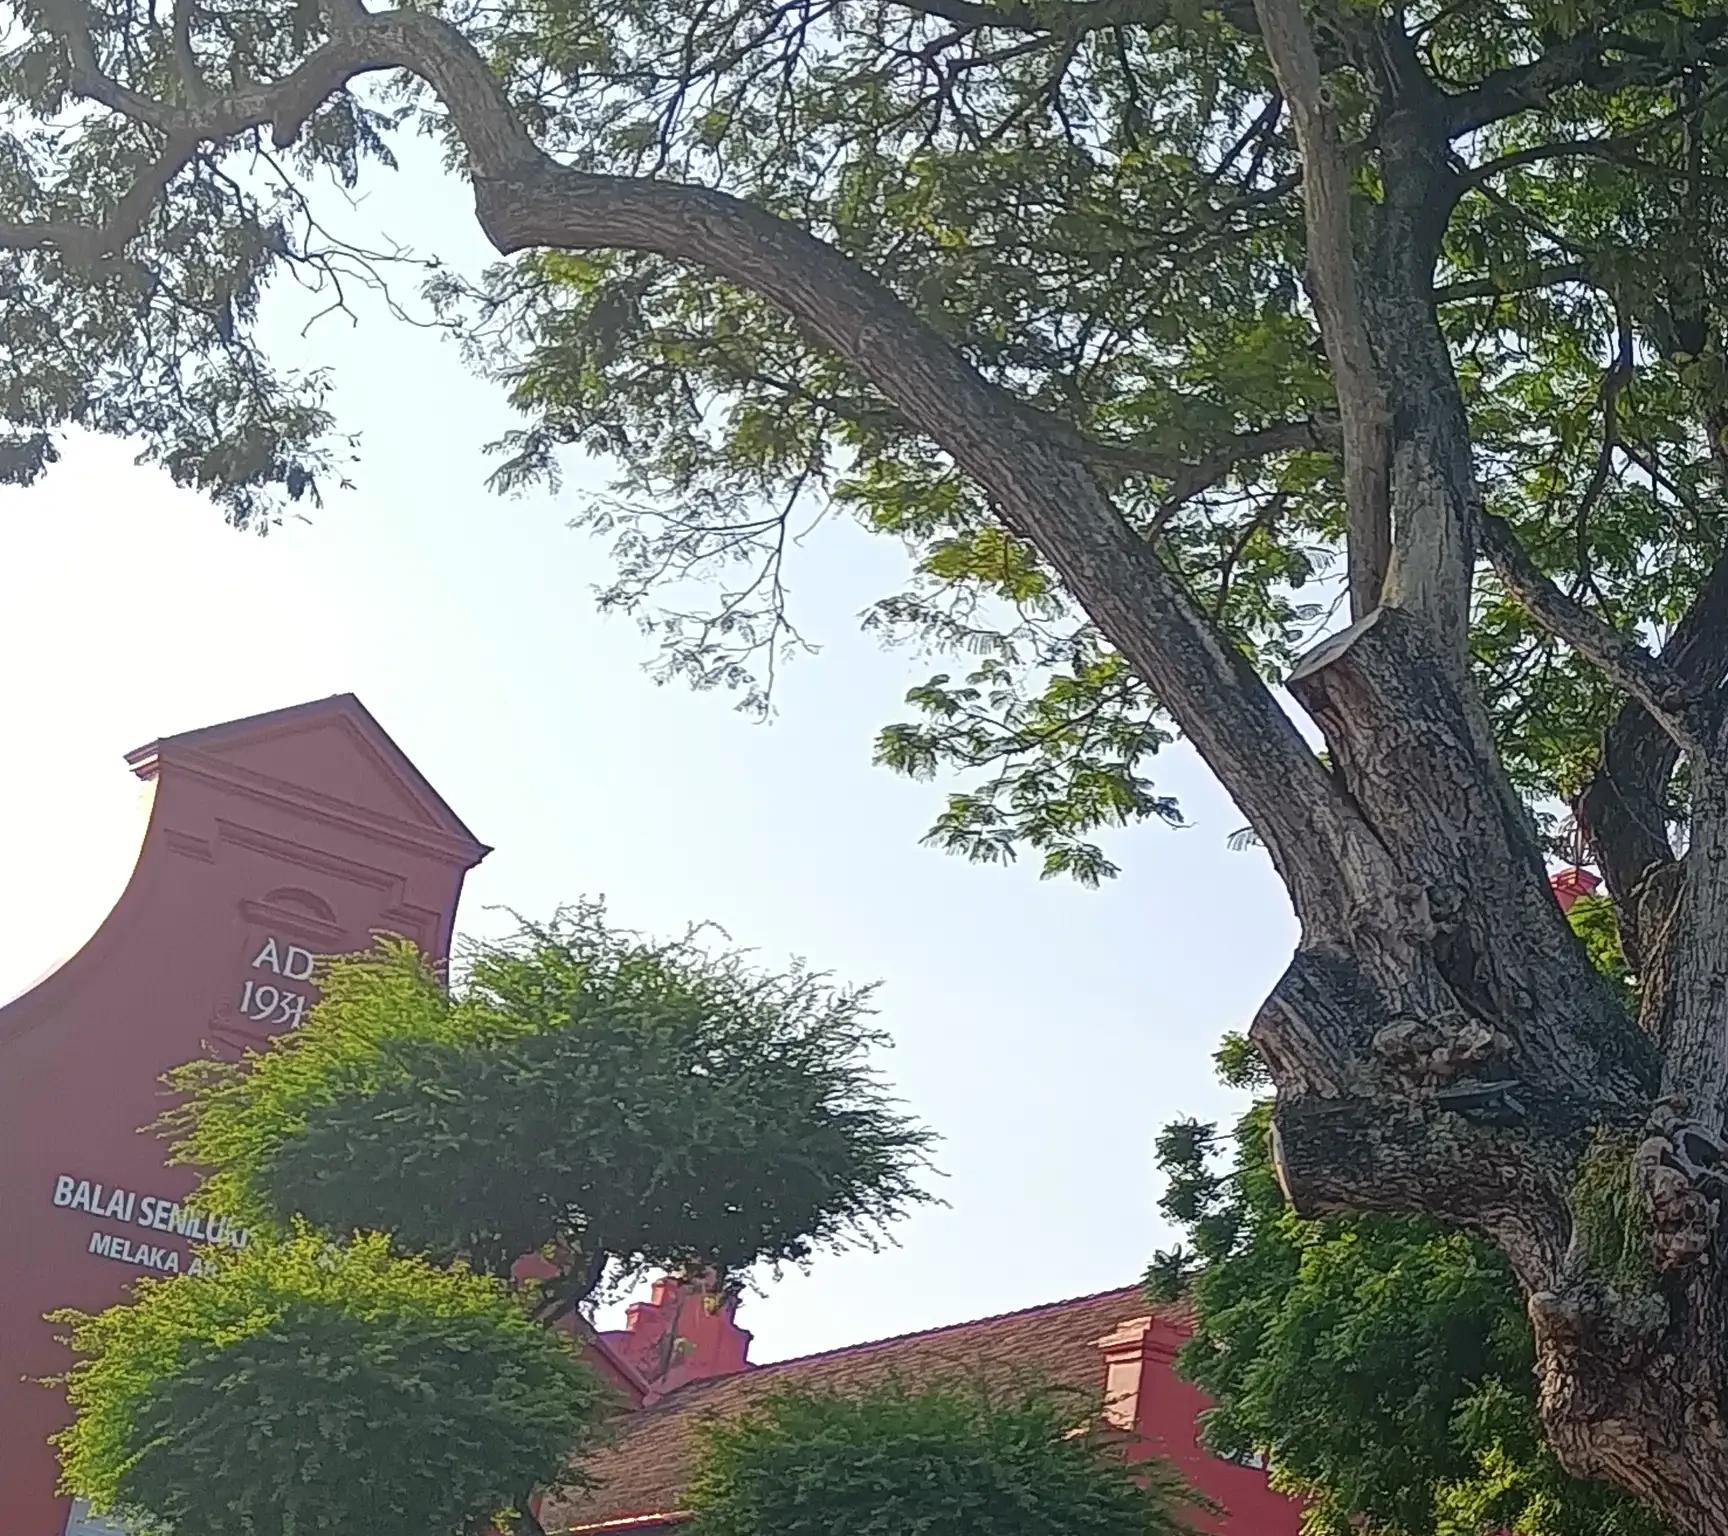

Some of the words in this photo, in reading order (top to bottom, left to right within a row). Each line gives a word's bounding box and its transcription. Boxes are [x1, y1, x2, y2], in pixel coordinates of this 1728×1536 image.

[252, 937, 314, 981] AD
[240, 981, 305, 1029] 1931
[53, 1175, 136, 1222] BALAI
[137, 1197, 193, 1237] SENI
[88, 1232, 179, 1273] MELAKA
